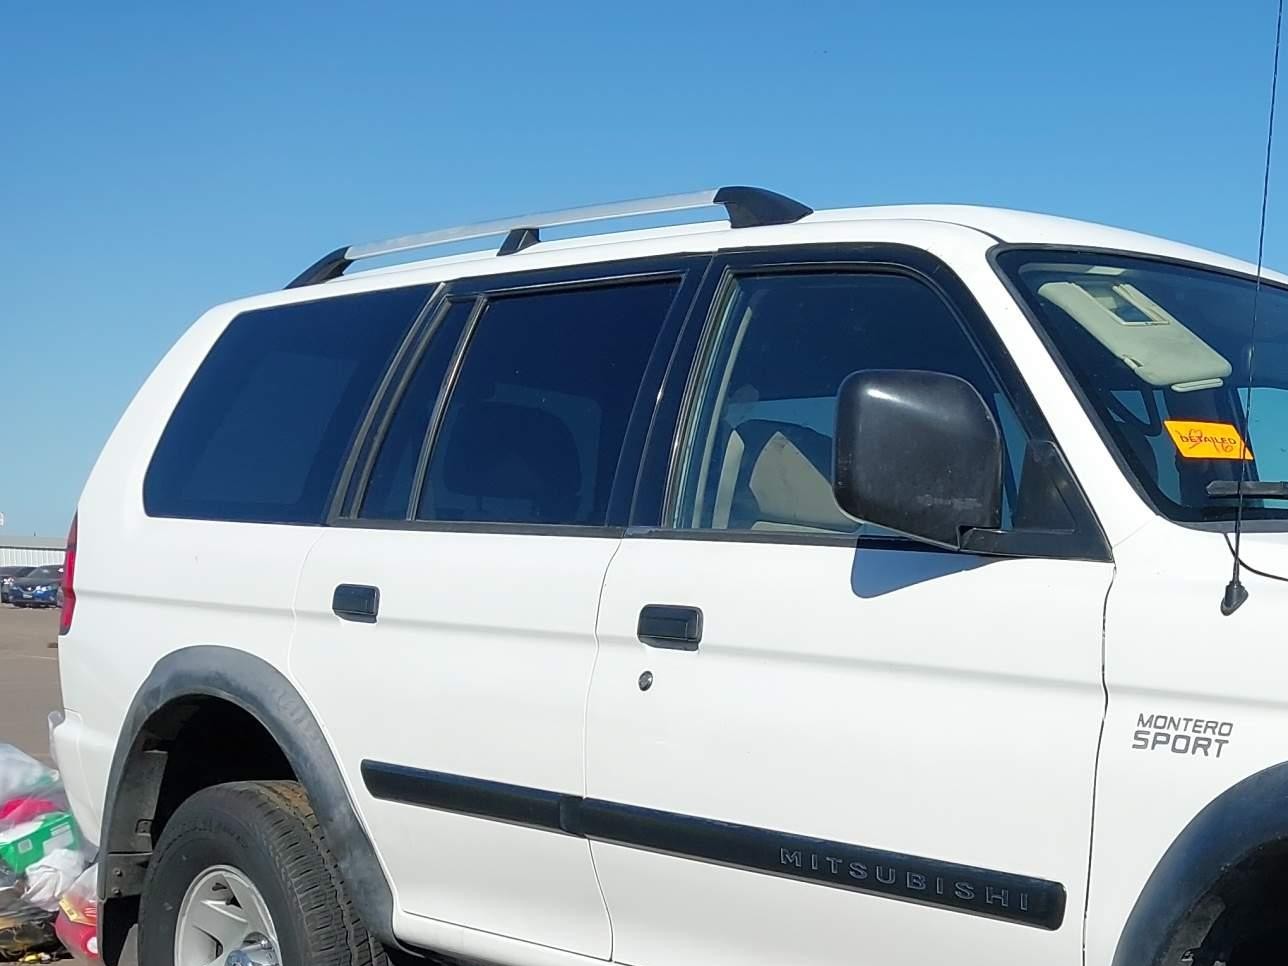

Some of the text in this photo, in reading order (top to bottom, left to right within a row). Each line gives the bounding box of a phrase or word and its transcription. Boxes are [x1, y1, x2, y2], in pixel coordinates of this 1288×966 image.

[1136, 713, 1234, 737] MONTERO
[1132, 730, 1230, 758] SPORT
[780, 846, 1031, 912] MITSUBISHI
